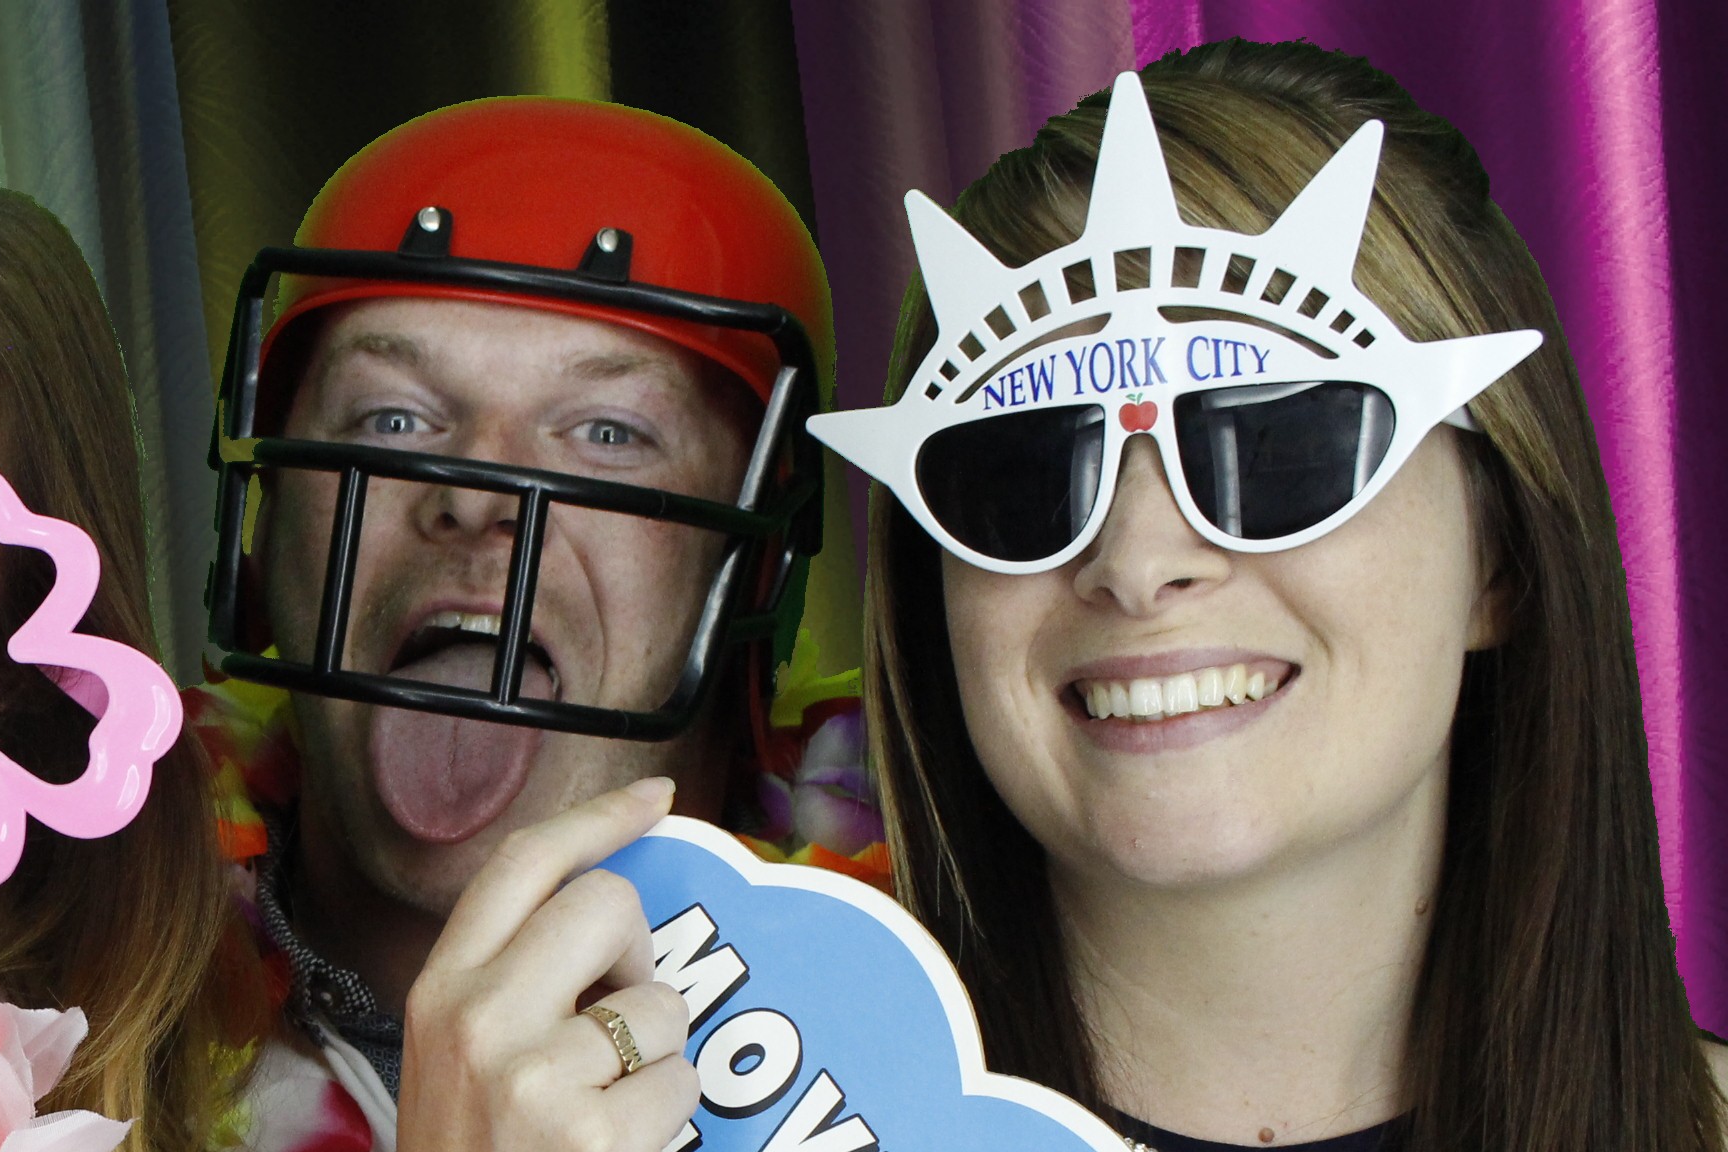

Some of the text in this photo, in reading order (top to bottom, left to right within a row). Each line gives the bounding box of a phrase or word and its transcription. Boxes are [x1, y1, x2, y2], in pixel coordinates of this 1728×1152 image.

[981, 335, 1271, 410] NEW YORK CITY
